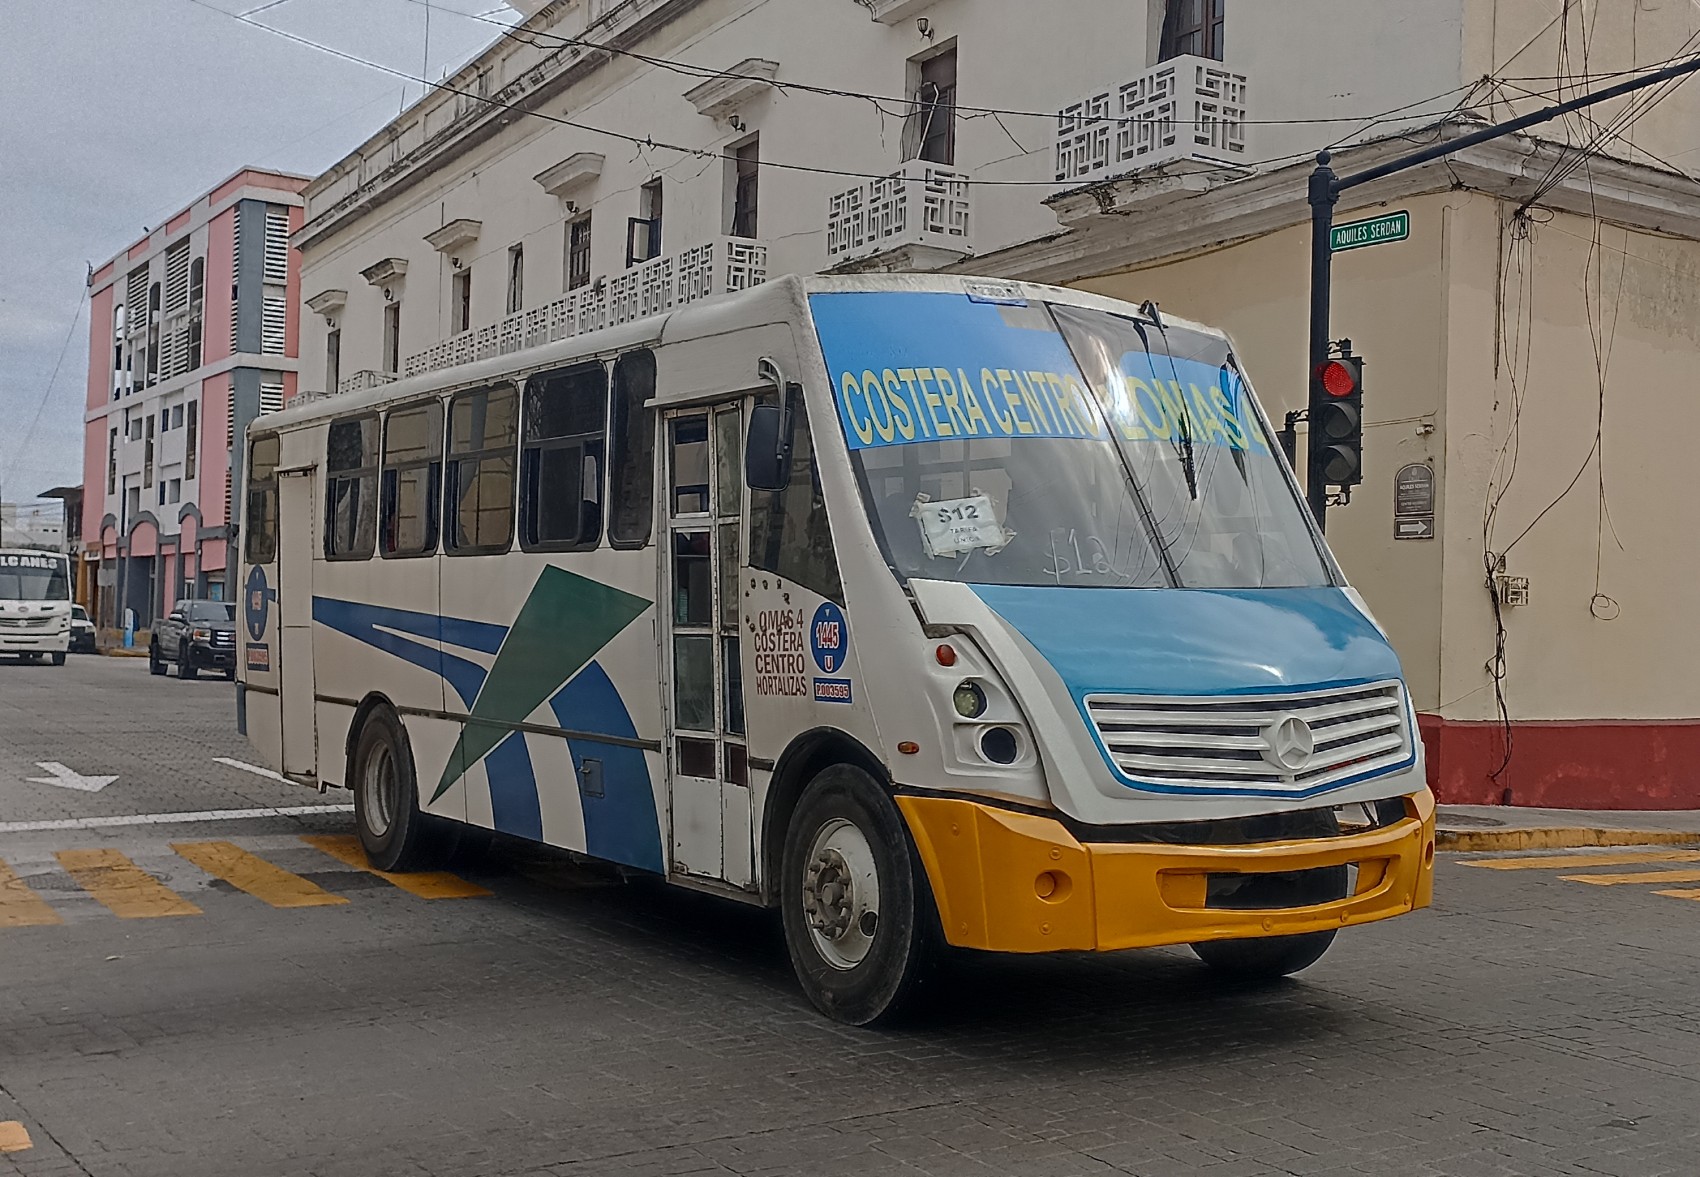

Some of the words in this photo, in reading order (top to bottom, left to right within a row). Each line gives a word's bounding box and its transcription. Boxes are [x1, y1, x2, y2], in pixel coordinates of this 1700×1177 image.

[1336, 226, 1367, 244] AQUILES
[1370, 220, 1401, 239] SERDAN
[841, 367, 993, 445] COSTERA
[981, 367, 1098, 437] CENTRO
[1042, 528, 1130, 585] $12
[796, 608, 804, 629] 4
[754, 631, 804, 652] COSTERA
[816, 622, 839, 649] 1445
[755, 653, 805, 674] CENTRO
[825, 655, 833, 671] U
[756, 675, 806, 697] HORTALIZAS
